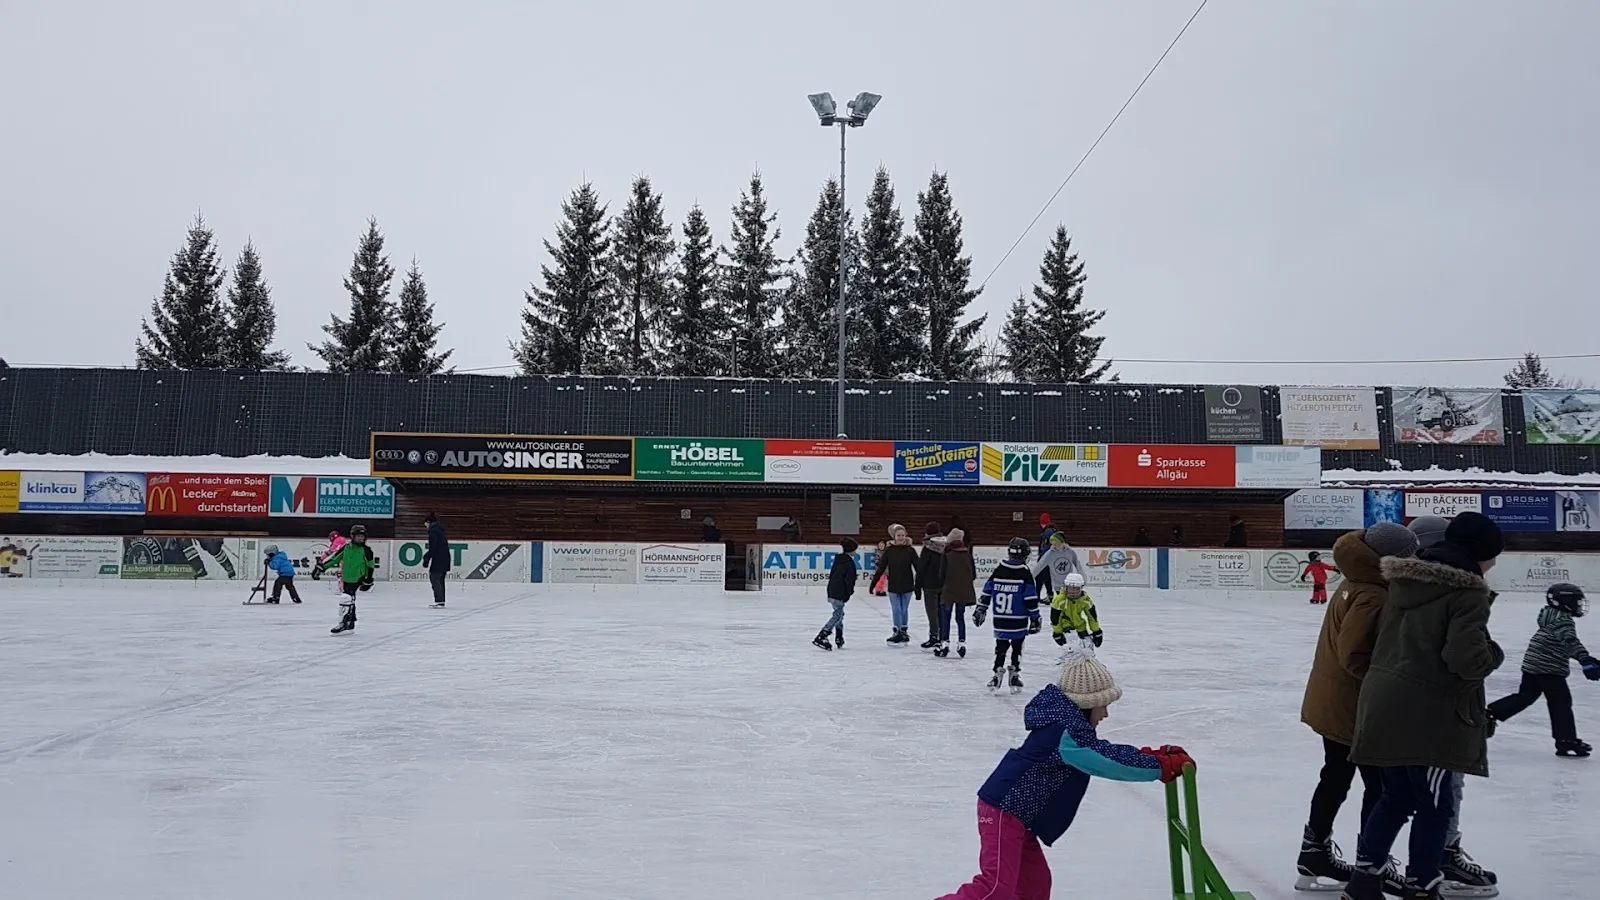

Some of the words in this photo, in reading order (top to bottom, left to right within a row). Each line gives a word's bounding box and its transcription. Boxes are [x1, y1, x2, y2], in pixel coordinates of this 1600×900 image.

[486, 441, 584, 450] WWW.AUTOSINGER.DE
[1004, 444, 1038, 452] Rolladen
[670, 442, 744, 461] HÖBEL
[896, 444, 942, 458] Fahrschule
[440, 450, 584, 470] AUTOSINGER
[1156, 457, 1206, 468] Sparkasse
[1004, 454, 1060, 482] Pilz
[1156, 470, 1188, 480] Allgäu
[202, 476, 222, 484] nach
[224, 476, 242, 484] dem
[244, 476, 267, 486] Spiel:
[27, 482, 76, 494] klinkau
[320, 479, 391, 496] minck
[182, 488, 218, 498] Lecker
[320, 498, 384, 506] ELEKTROTECHNIK
[1294, 494, 1310, 504] ICE,
[1312, 494, 1328, 504] ICE,
[1331, 495, 1354, 504] BABY
[1408, 494, 1430, 508] Lipp
[1432, 494, 1478, 504] BÄCKEREI
[198, 502, 266, 512] durchstarten!
[1432, 505, 1456, 515] CAFÉ
[398, 542, 468, 567] OT
[594, 548, 636, 557] energie
[645, 553, 722, 562] HÖRMANNSHOFER
[479, 546, 510, 578] JAKOB
[1218, 561, 1244, 570] Lutz
[122, 565, 160, 573] Landgasthof
[164, 565, 192, 573] Hubertus
[398, 570, 461, 580] Spannnik
[994, 584, 1019, 592] STAMKOS
[996, 592, 1014, 614] 91
